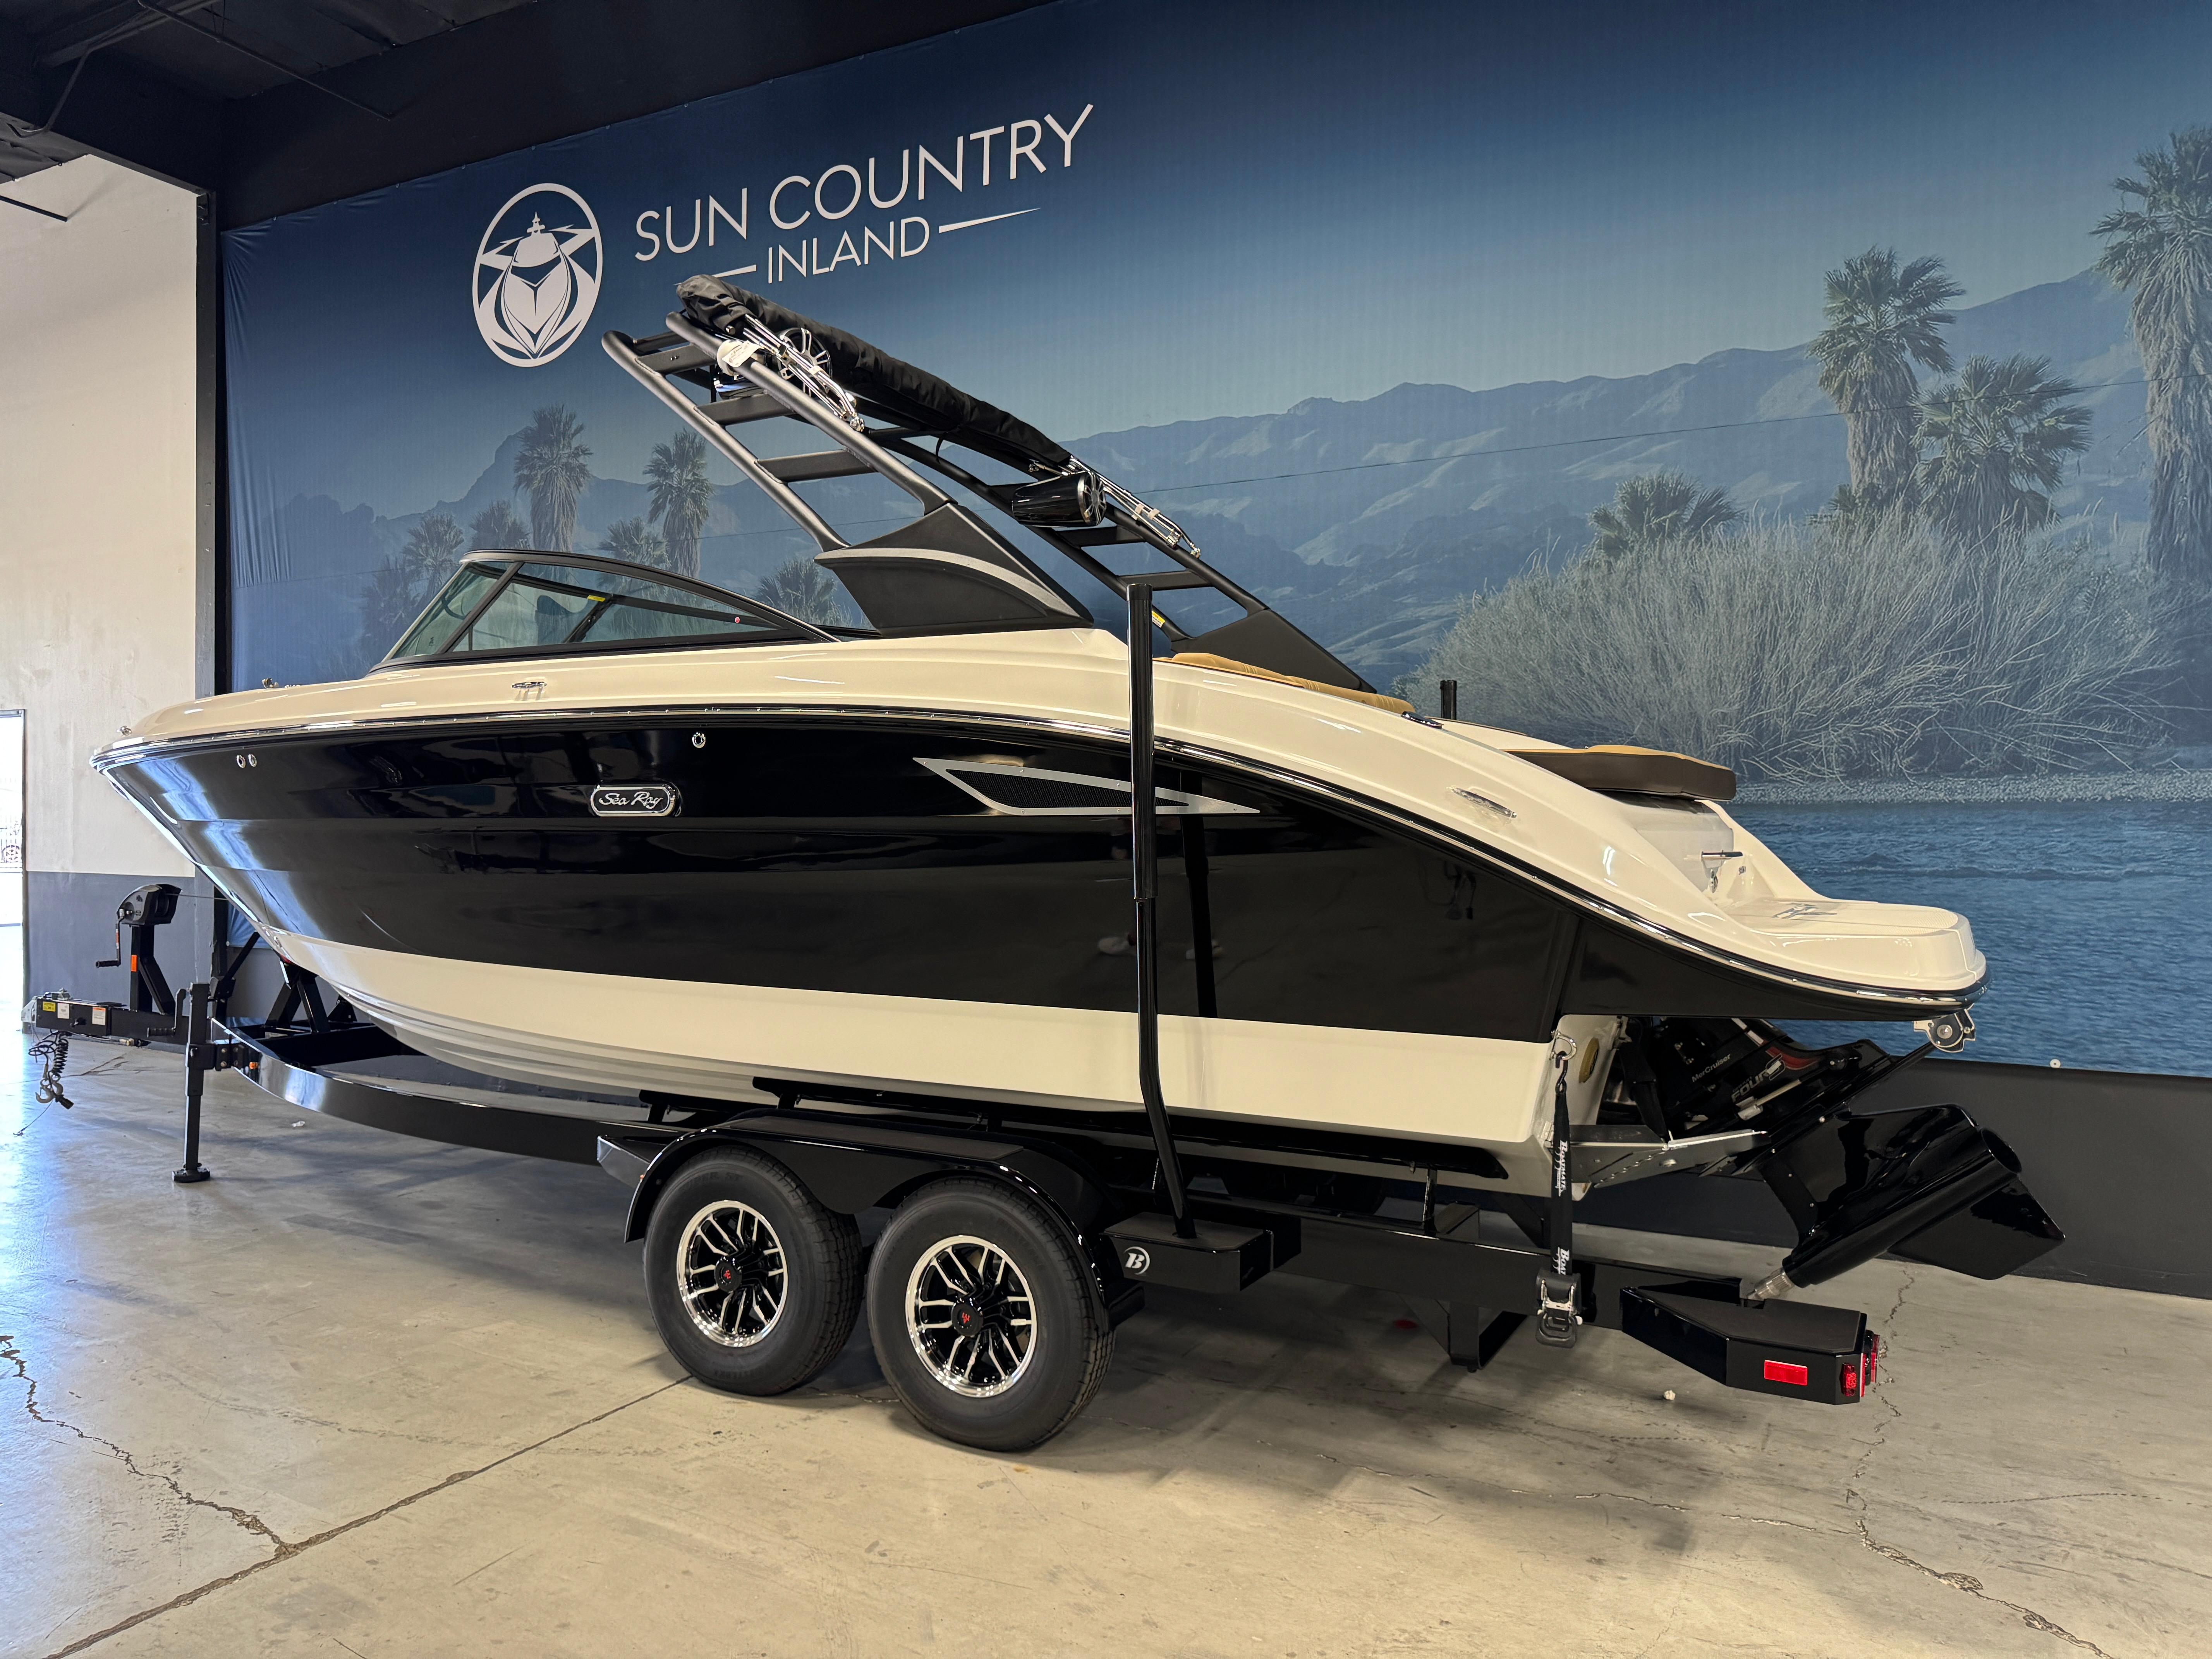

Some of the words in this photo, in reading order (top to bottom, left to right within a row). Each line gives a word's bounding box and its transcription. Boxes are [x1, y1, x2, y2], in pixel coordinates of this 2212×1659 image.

[635, 187, 747, 261] SUN
[769, 104, 1094, 230] COUNTRY
[768, 216, 929, 284] INLAND
[599, 792, 630, 805] Sea
[631, 791, 663, 809] Ray
[1692, 1054, 1731, 1082] MerCruiser
[1125, 1252, 1145, 1269] B
